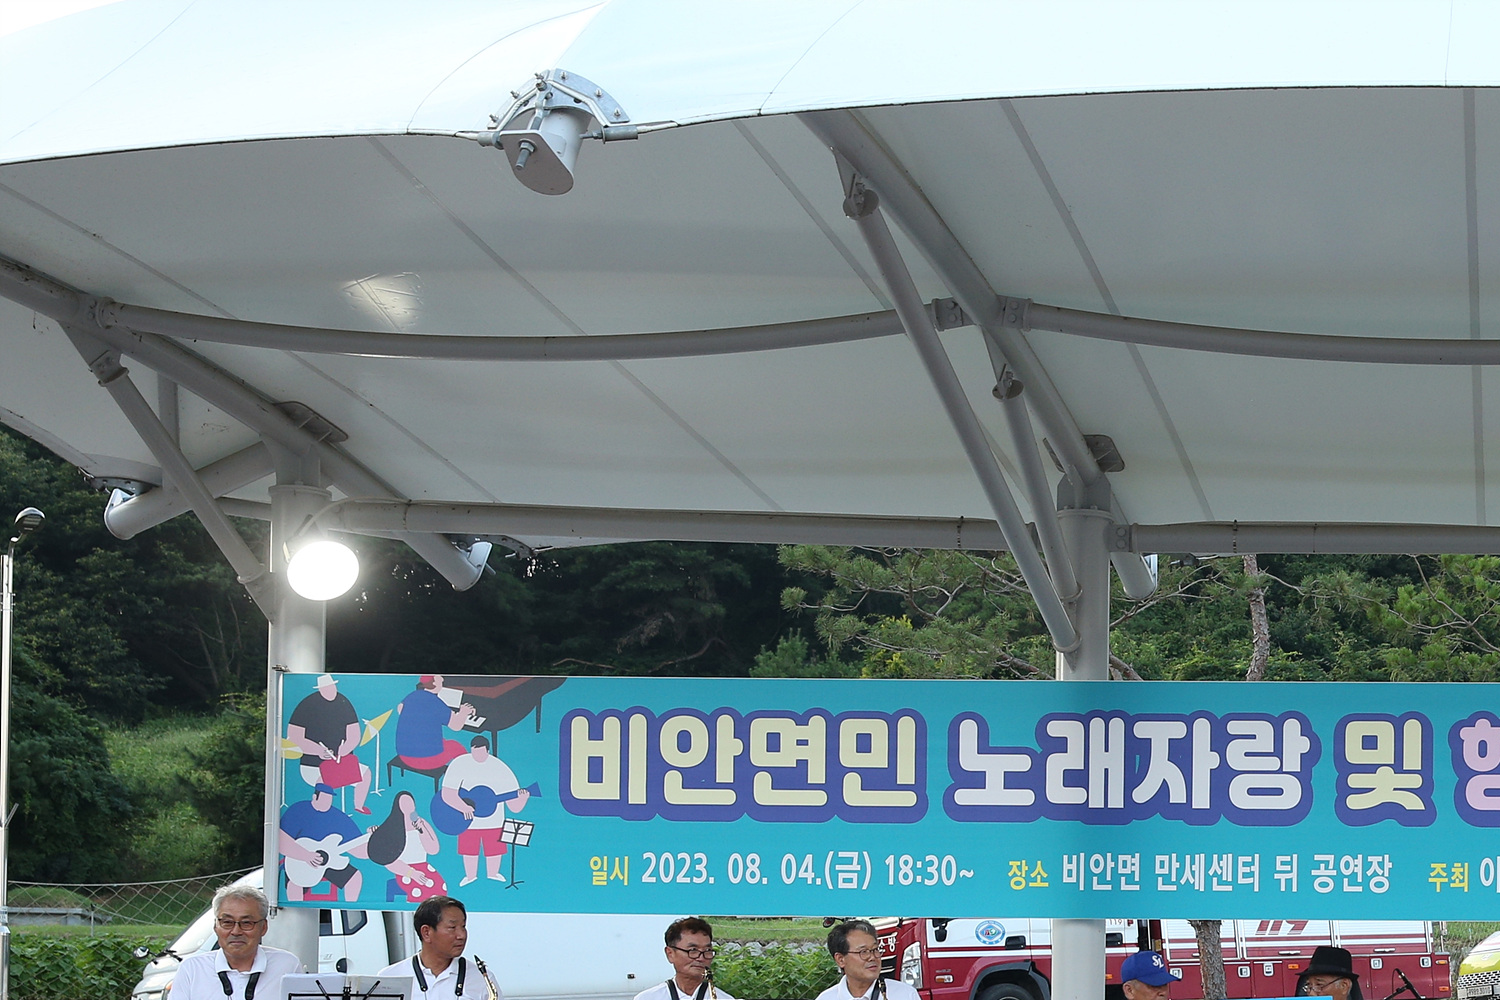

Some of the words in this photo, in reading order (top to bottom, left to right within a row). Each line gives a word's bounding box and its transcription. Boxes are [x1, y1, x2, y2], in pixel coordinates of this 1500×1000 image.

[569, 713, 919, 809] 비안면민
[952, 716, 1311, 811] 노래자랑
[1343, 717, 1426, 812] 및
[588, 854, 630, 887] 일시
[640, 850, 715, 885] 2023.
[726, 851, 768, 886] 08.
[779, 849, 872, 890] 04.(금)
[883, 853, 976, 887] 18:30~
[1006, 858, 1049, 891] 장소
[1061, 852, 1141, 892] 비안면
[1153, 853, 1261, 893] 만세센터
[1272, 853, 1299, 894] 뒤
[1309, 854, 1393, 894] 공연장
[1427, 861, 1469, 893] 주최
